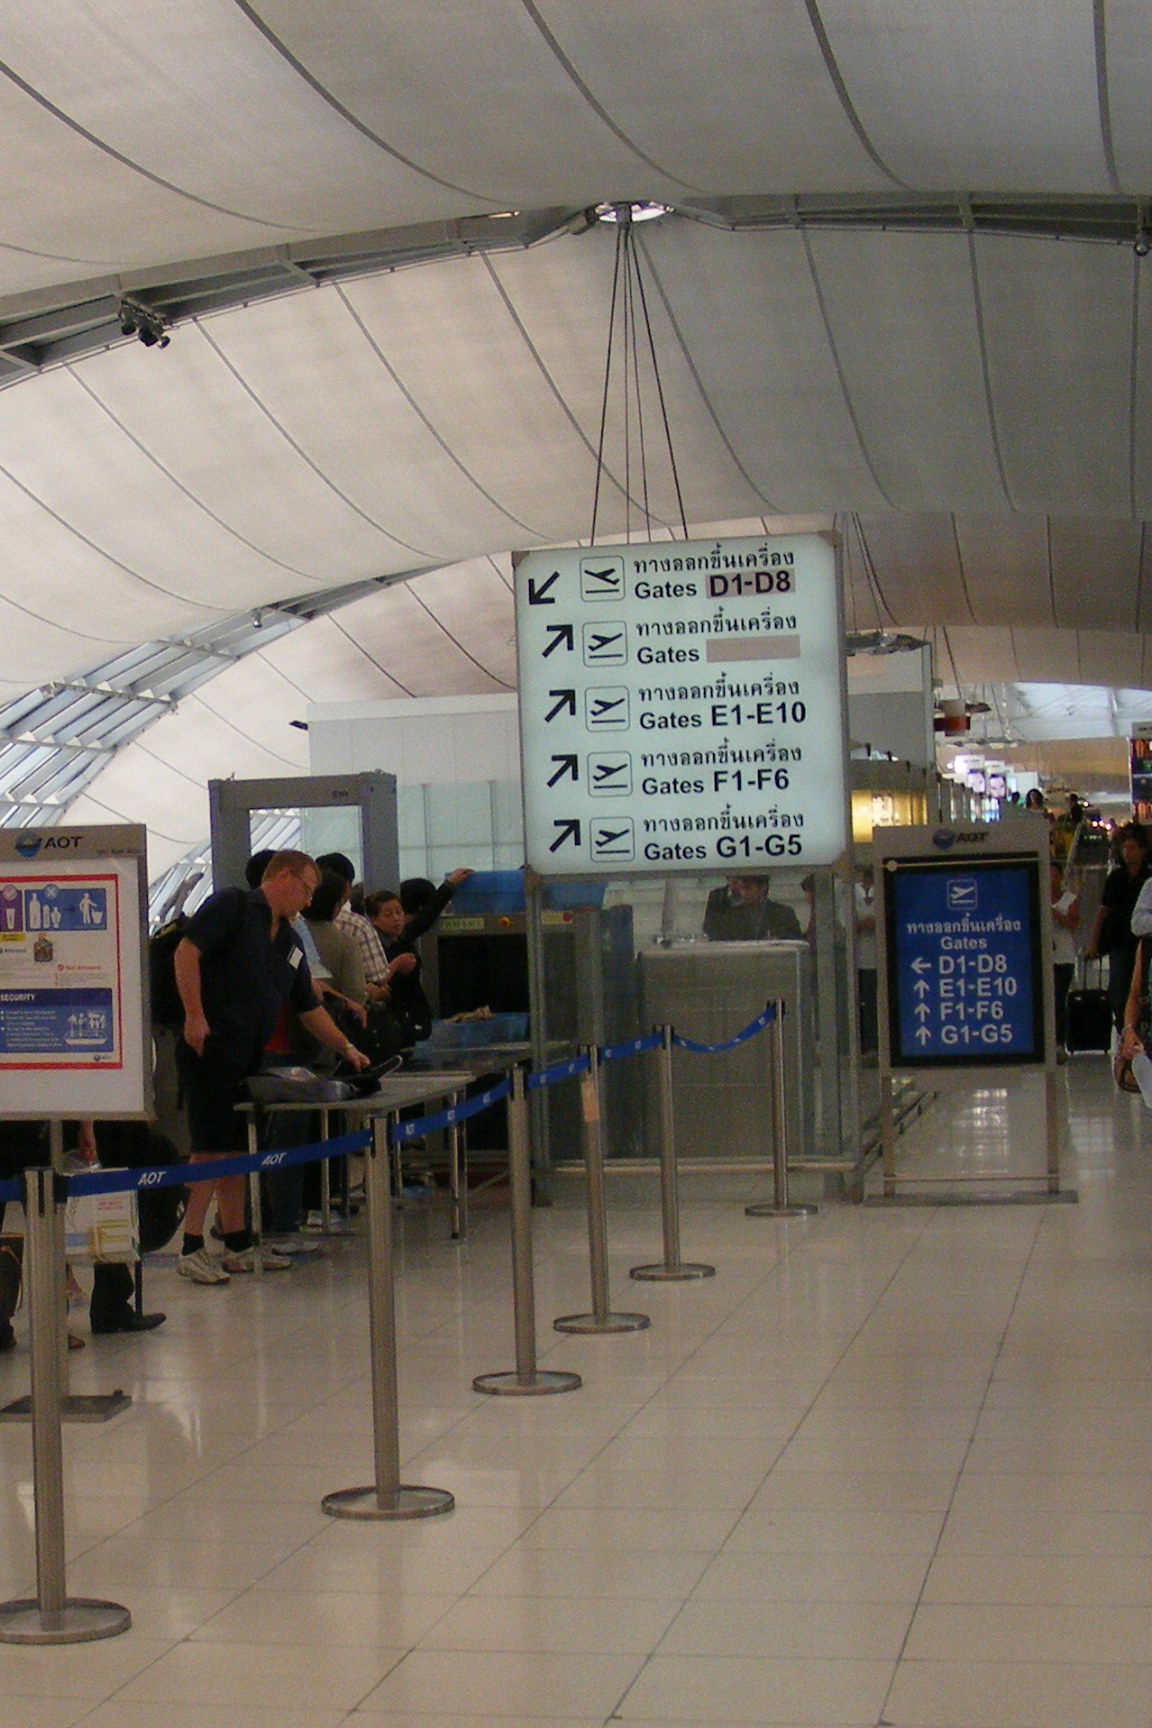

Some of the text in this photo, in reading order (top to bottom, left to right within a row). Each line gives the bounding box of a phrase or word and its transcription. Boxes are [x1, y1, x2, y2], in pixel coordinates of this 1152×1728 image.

[634, 543, 794, 574] ทางออกขึ้นเครื่อง
[634, 570, 791, 600] Gates D1-D8
[636, 606, 797, 637] ทางออกขึ้นเครื่อง
[637, 644, 700, 665] Gates
[638, 672, 799, 702] ทางออกขึ้นเครื่อง
[639, 701, 806, 730] Gates E1-E10
[640, 737, 802, 768] ทางออกขึ้นเครื่อง
[642, 768, 790, 796] Gates F1-F6
[643, 803, 804, 833] ทางออกขึ้นเครื่อง
[44, 836, 83, 849] AOT
[644, 834, 802, 861] Gates G1-G5
[956, 831, 989, 843] AOT
[940, 936, 988, 950] Gates
[938, 954, 1007, 974] D1-D8
[938, 977, 1017, 997] E1-E10
[940, 1001, 1004, 1020] F1-F6
[941, 1024, 1013, 1043] G1-G5
[261, 1152, 288, 1166] AOT
[137, 1170, 167, 1186] AOT
